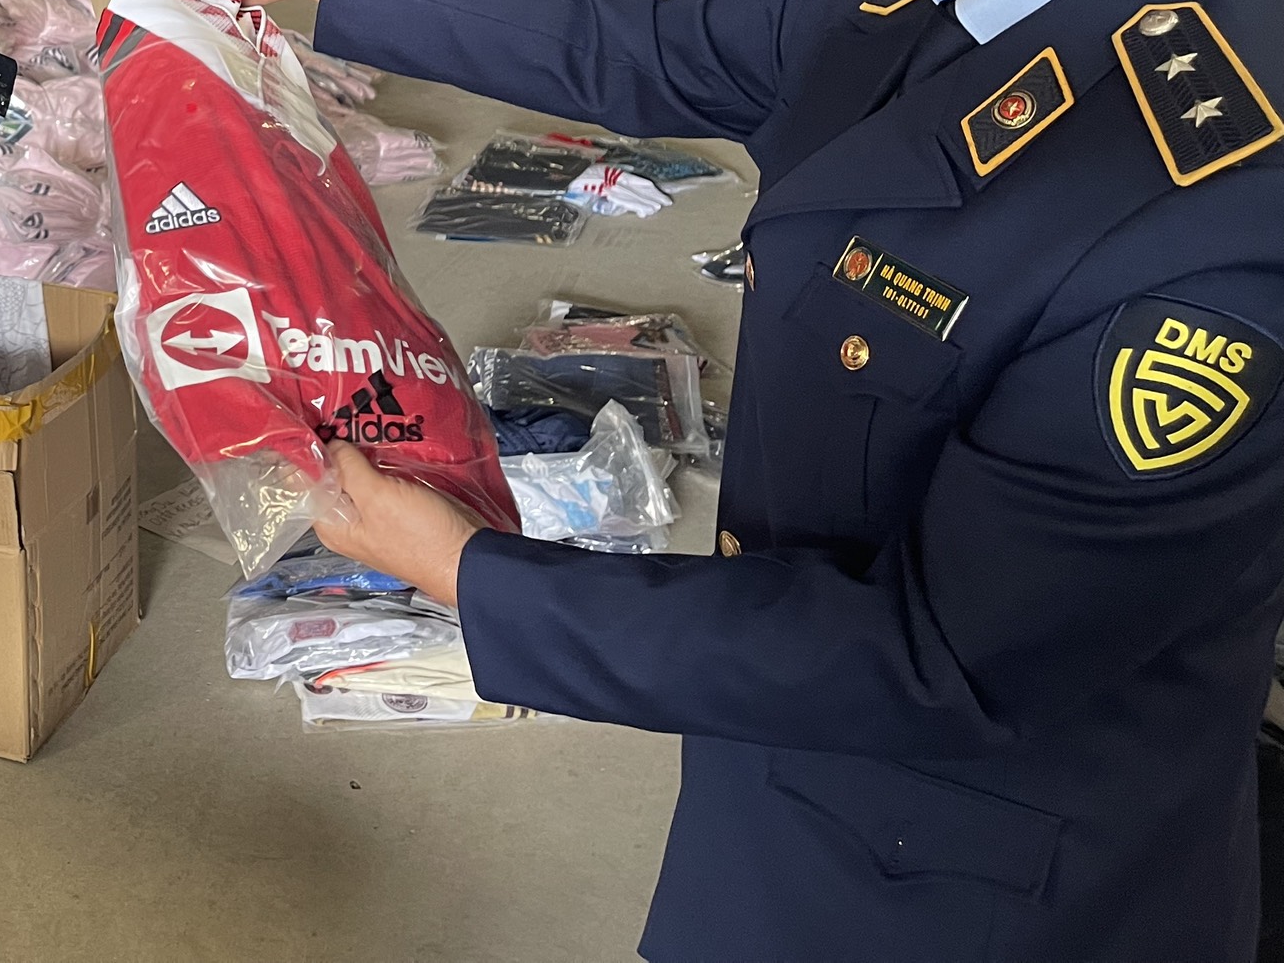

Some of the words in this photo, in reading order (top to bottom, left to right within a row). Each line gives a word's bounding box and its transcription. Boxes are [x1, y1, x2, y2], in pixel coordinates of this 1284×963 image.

[145, 209, 221, 234] adidas
[893, 272, 924, 296] QUANG
[922, 287, 952, 312] TRỊNH
[1154, 317, 1253, 373] DMS
